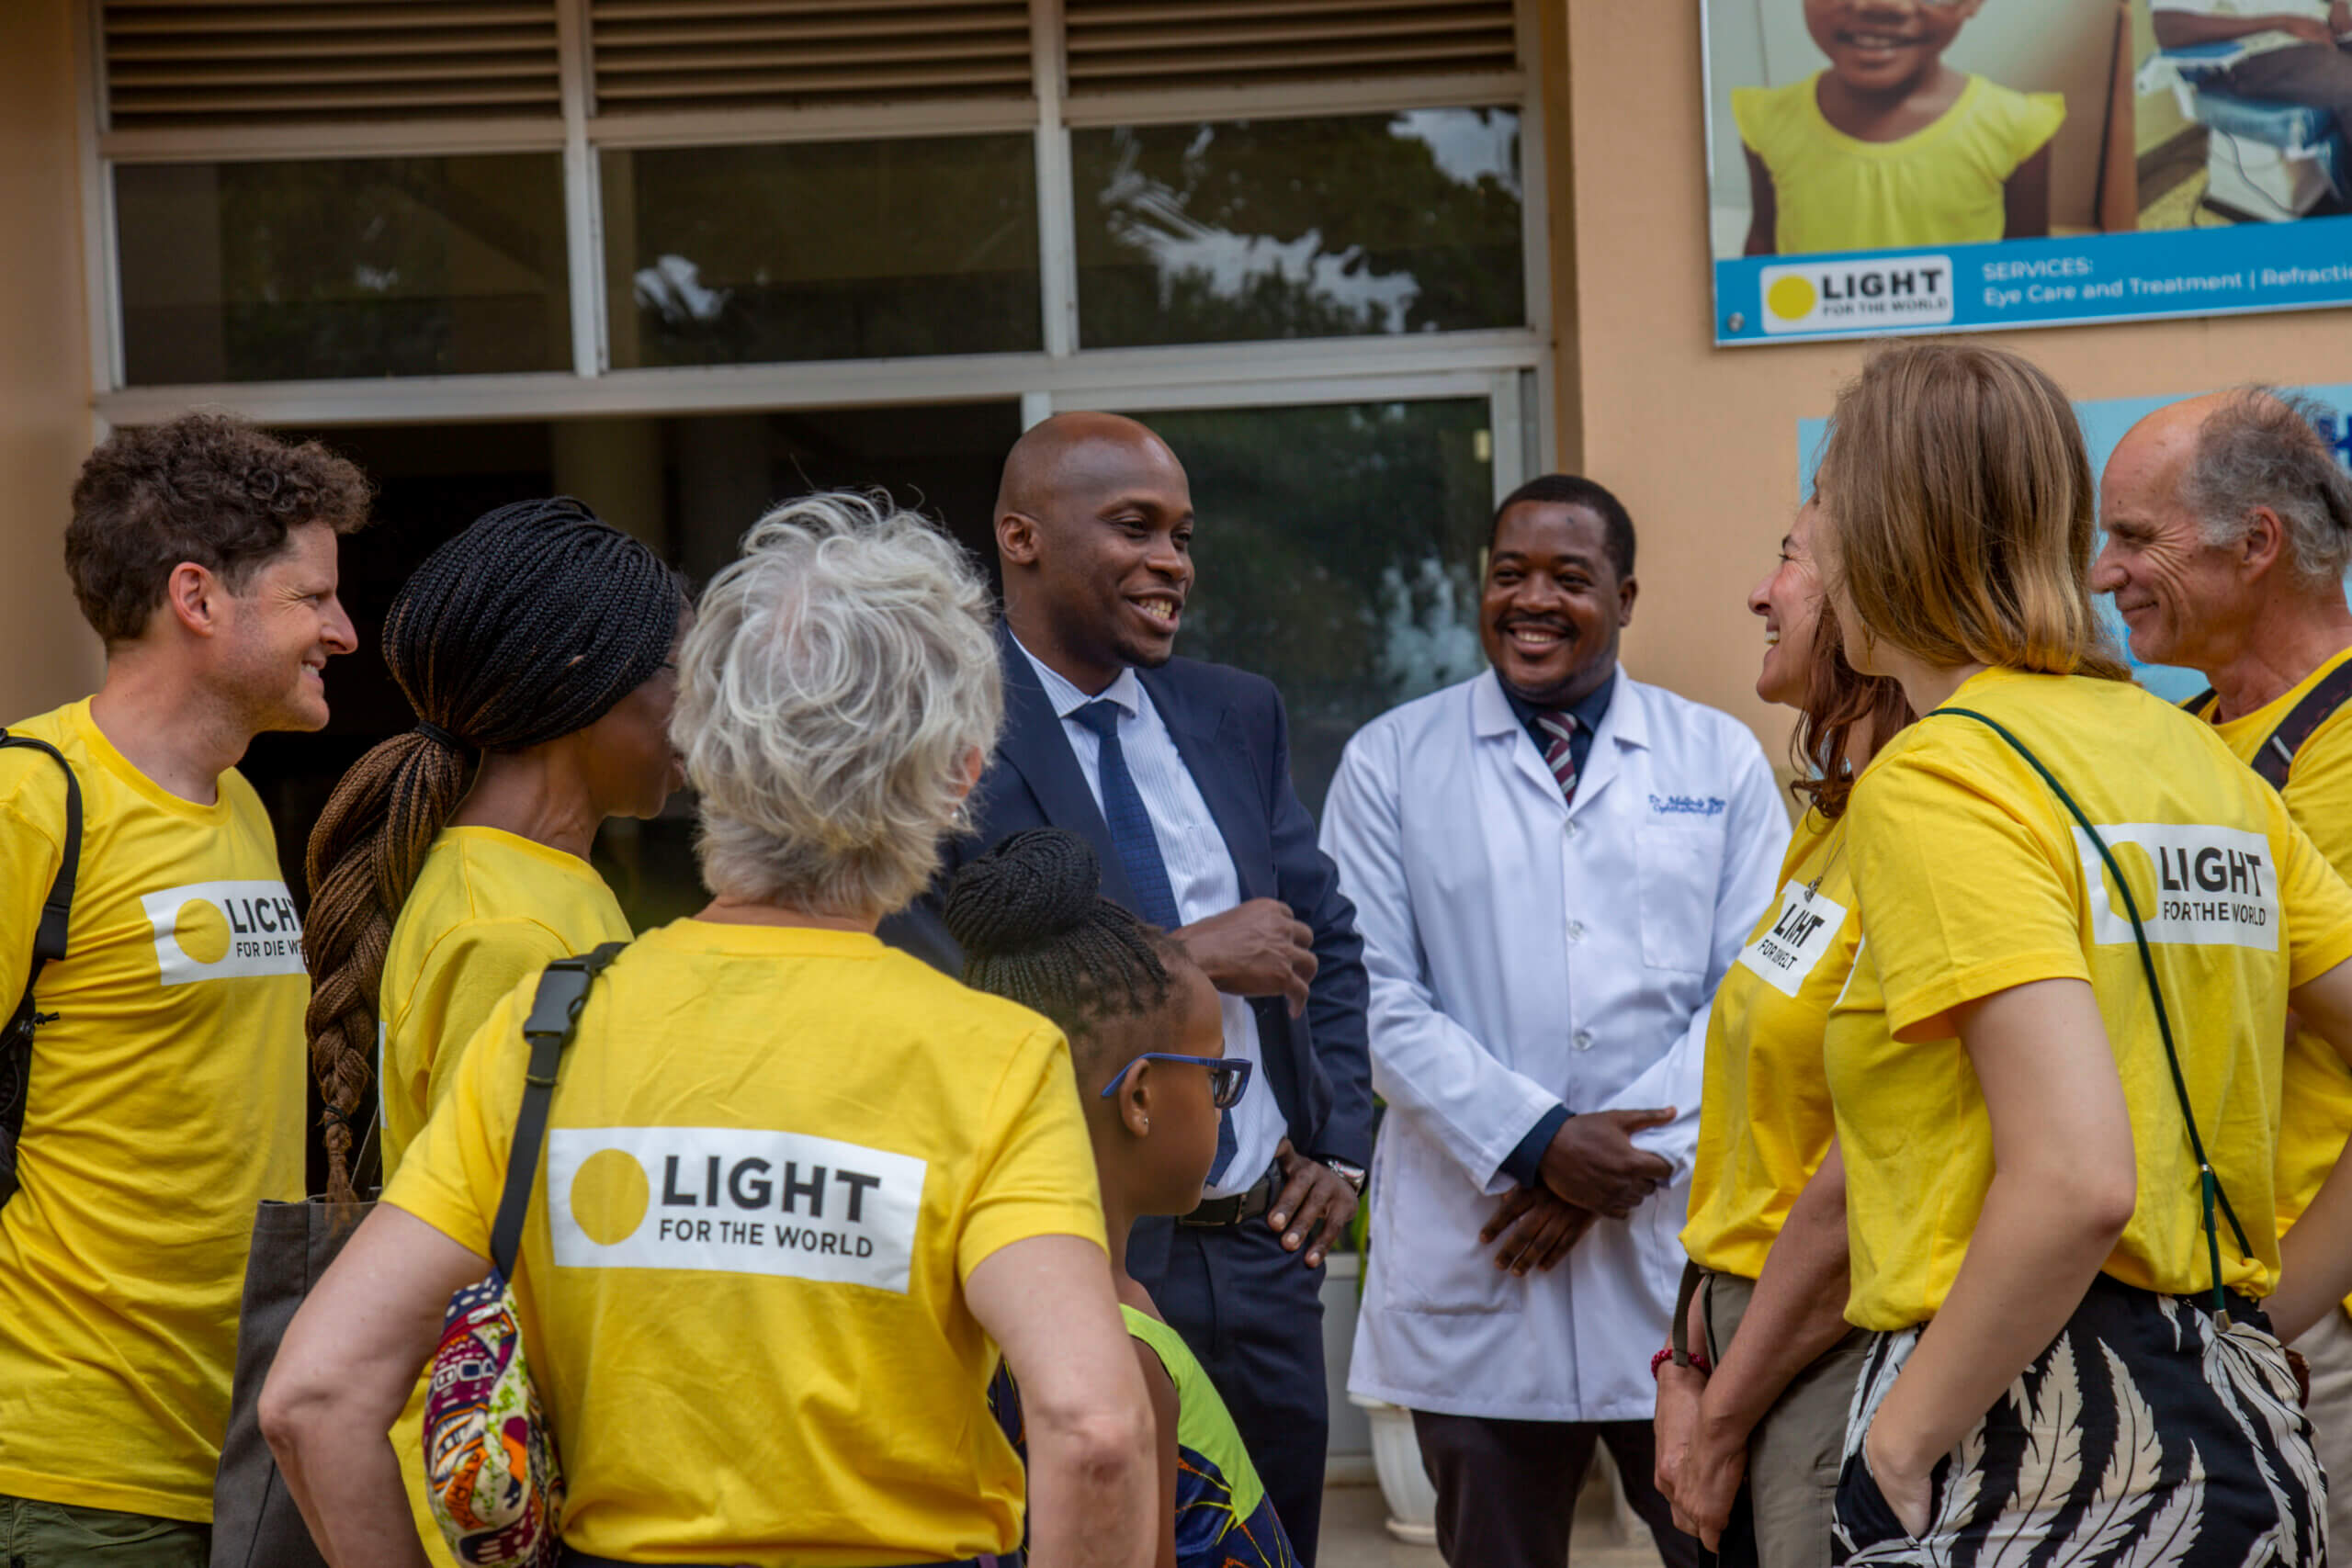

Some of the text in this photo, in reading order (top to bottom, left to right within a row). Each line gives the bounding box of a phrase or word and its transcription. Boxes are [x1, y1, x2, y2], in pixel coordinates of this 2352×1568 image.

[1823, 268, 1943, 299] LIGHT
[1983, 256, 2093, 282] SERVICES:
[1984, 287, 2022, 309] Eye
[2027, 284, 2076, 303] Care
[2082, 278, 2123, 299] and
[2129, 272, 2242, 295] Treatment
[1823, 298, 1949, 317] FOR THE WORLD
[2159, 846, 2262, 897] LIGHT
[2163, 901, 2267, 927] FOR THE WORLD
[264, 940, 285, 957] DIE
[662, 1154, 881, 1223] LIGHT
[659, 1218, 874, 1258] FOR THE WORLD
